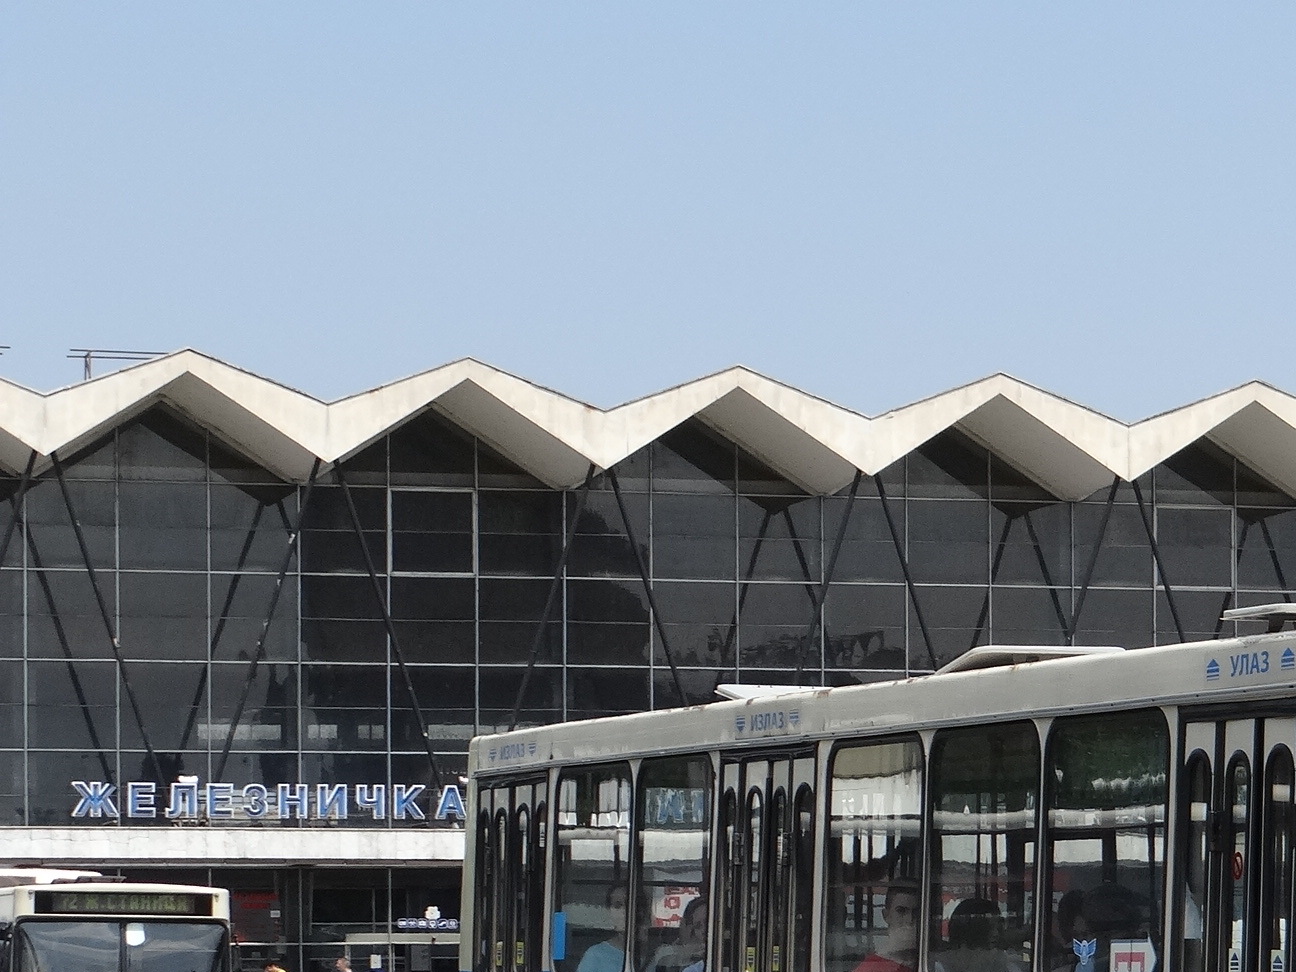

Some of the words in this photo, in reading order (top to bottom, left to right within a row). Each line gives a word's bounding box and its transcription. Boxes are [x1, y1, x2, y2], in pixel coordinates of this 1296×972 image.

[1230, 651, 1270, 677] УЛАЗ
[750, 711, 785, 732] ИЗЛАЗ
[71, 781, 467, 820] ЖЕЛЕЗНИЧКА
